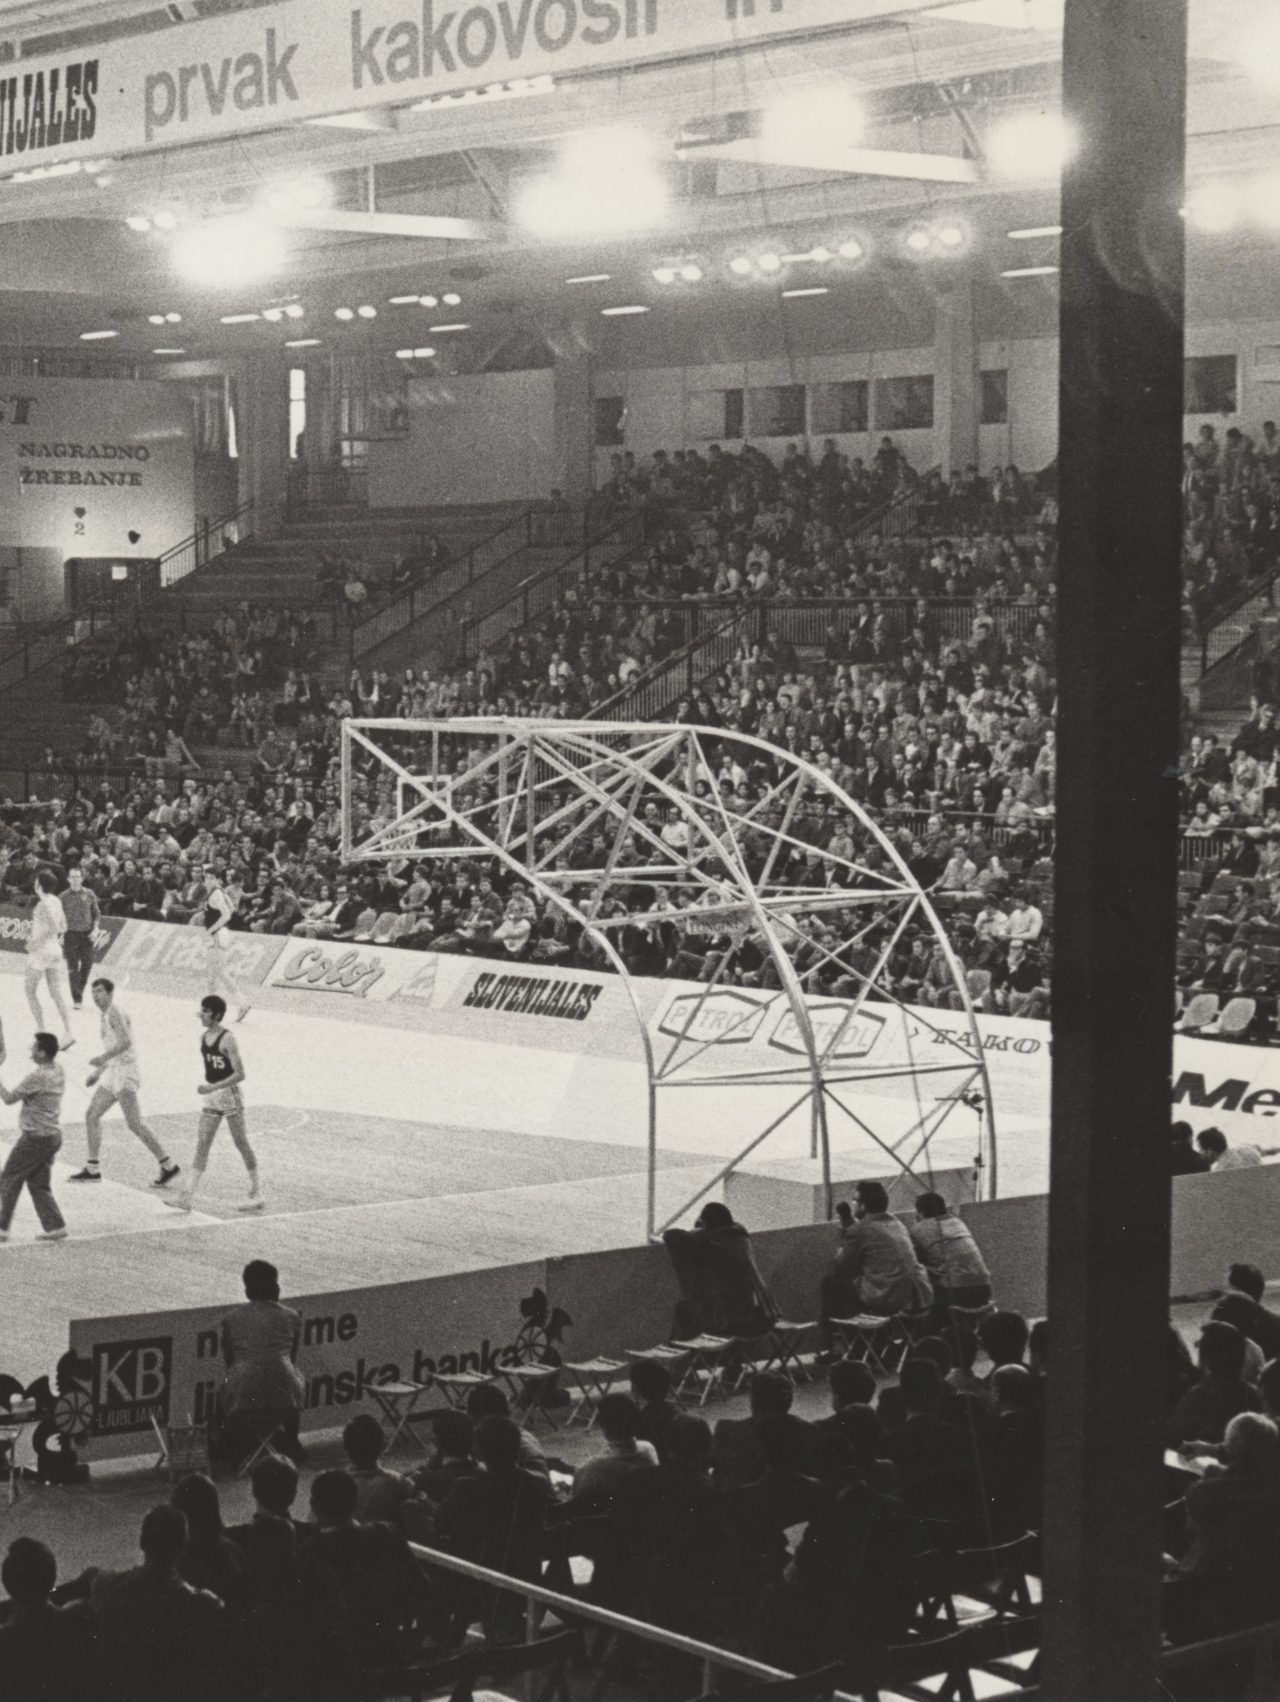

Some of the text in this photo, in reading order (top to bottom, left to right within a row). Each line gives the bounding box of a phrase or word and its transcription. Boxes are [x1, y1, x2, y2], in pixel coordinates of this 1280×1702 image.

[143, 28, 300, 141] prvak
[20, 443, 150, 461] NAGRADNO
[75, 522, 85, 535] 2
[463, 972, 604, 1021] SLOVENIJALES
[670, 1006, 755, 1033] PTROL
[781, 1019, 870, 1047] PTROL
[210, 1055, 225, 1071] 15
[98, 1347, 166, 1405] KB
[413, 1339, 522, 1385] banka
